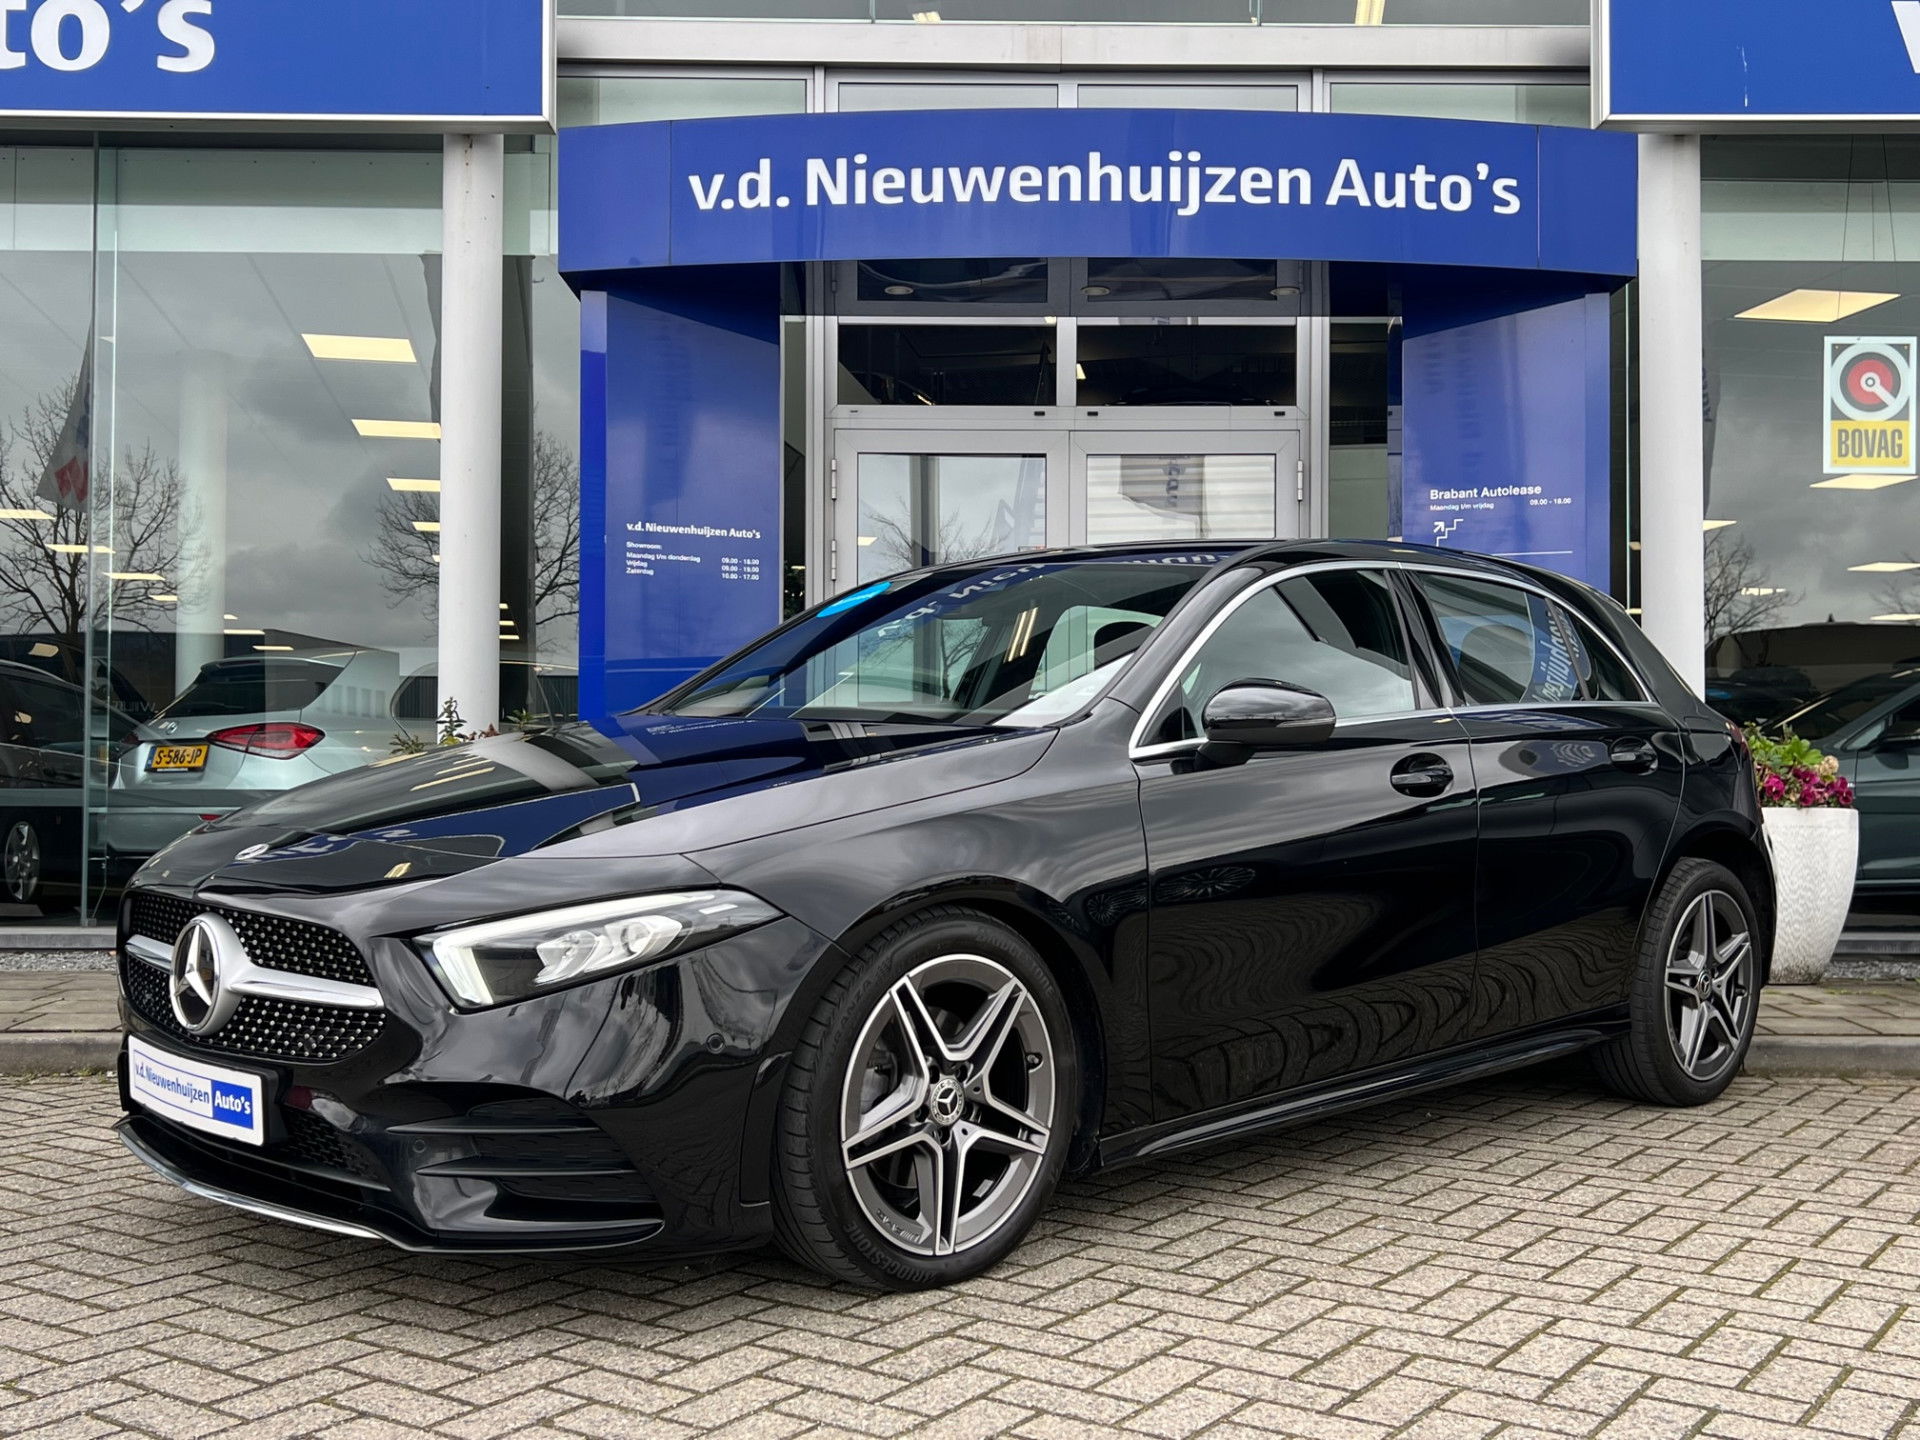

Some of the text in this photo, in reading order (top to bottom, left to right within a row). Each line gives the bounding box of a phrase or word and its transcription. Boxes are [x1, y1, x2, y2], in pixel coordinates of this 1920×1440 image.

[688, 151, 1521, 216] v.d. Nieuwenhuijzen Auto's
[1837, 428, 1903, 459] BOVAG
[1430, 485, 1542, 500] Brabant Autolease
[1430, 504, 1459, 512] Maandag
[1473, 502, 1494, 511] vrijdag
[626, 521, 761, 539] v.d. Nieuwenhuijzen Auto's
[626, 552, 655, 561] Maandag
[667, 554, 701, 563] donderdag
[626, 560, 648, 568] Vrijdag
[626, 567, 654, 576] Zaterdag
[155, 748, 203, 766] S-586-JP
[134, 1062, 251, 1115] v.d. Nieuwenhuijzen Auto's
[843, 1222, 937, 1284] BRIDGESTONE
